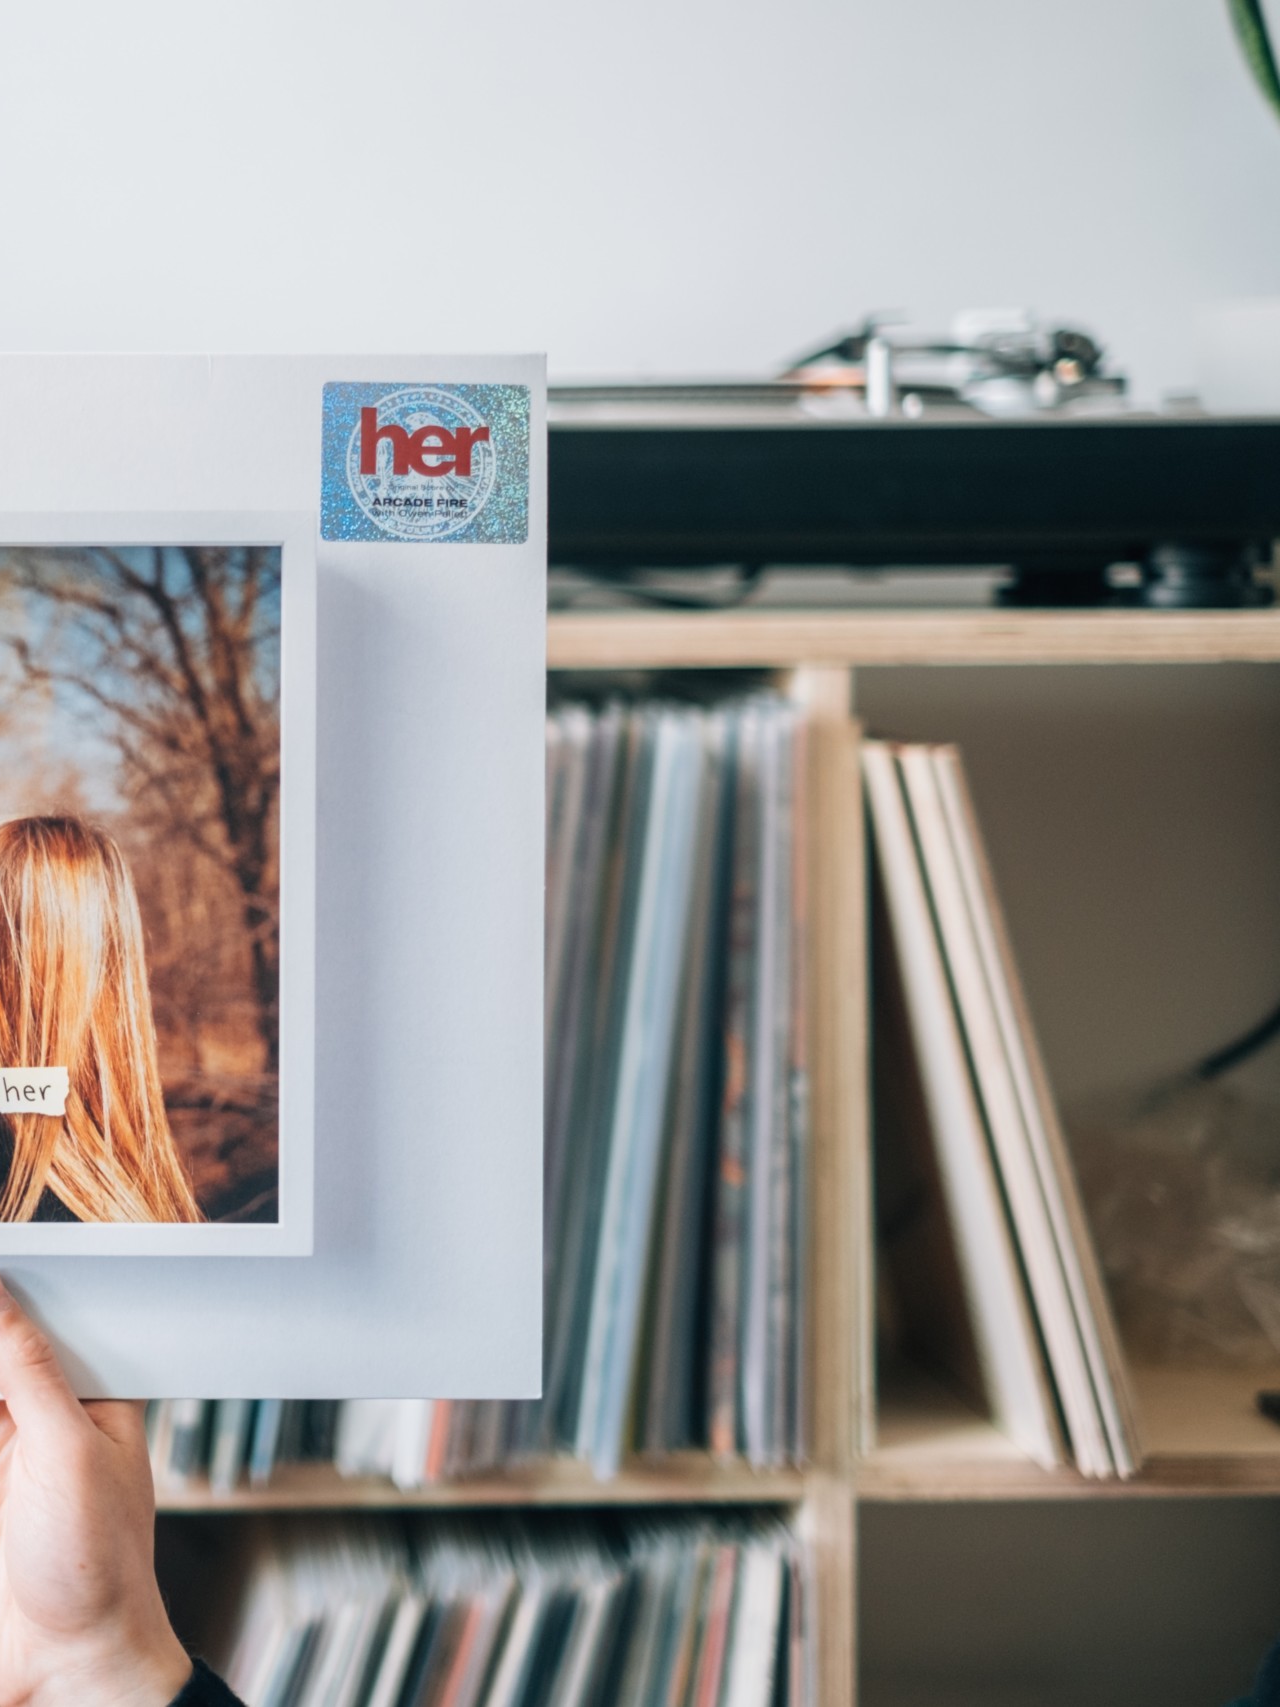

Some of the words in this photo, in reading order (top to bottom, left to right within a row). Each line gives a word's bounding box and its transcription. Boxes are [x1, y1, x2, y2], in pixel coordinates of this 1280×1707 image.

[360, 407, 490, 477] her
[372, 498, 434, 508] ARCADE
[437, 498, 469, 508] FIRE
[398, 509, 432, 518] Owen
[2, 1076, 52, 1103] her
